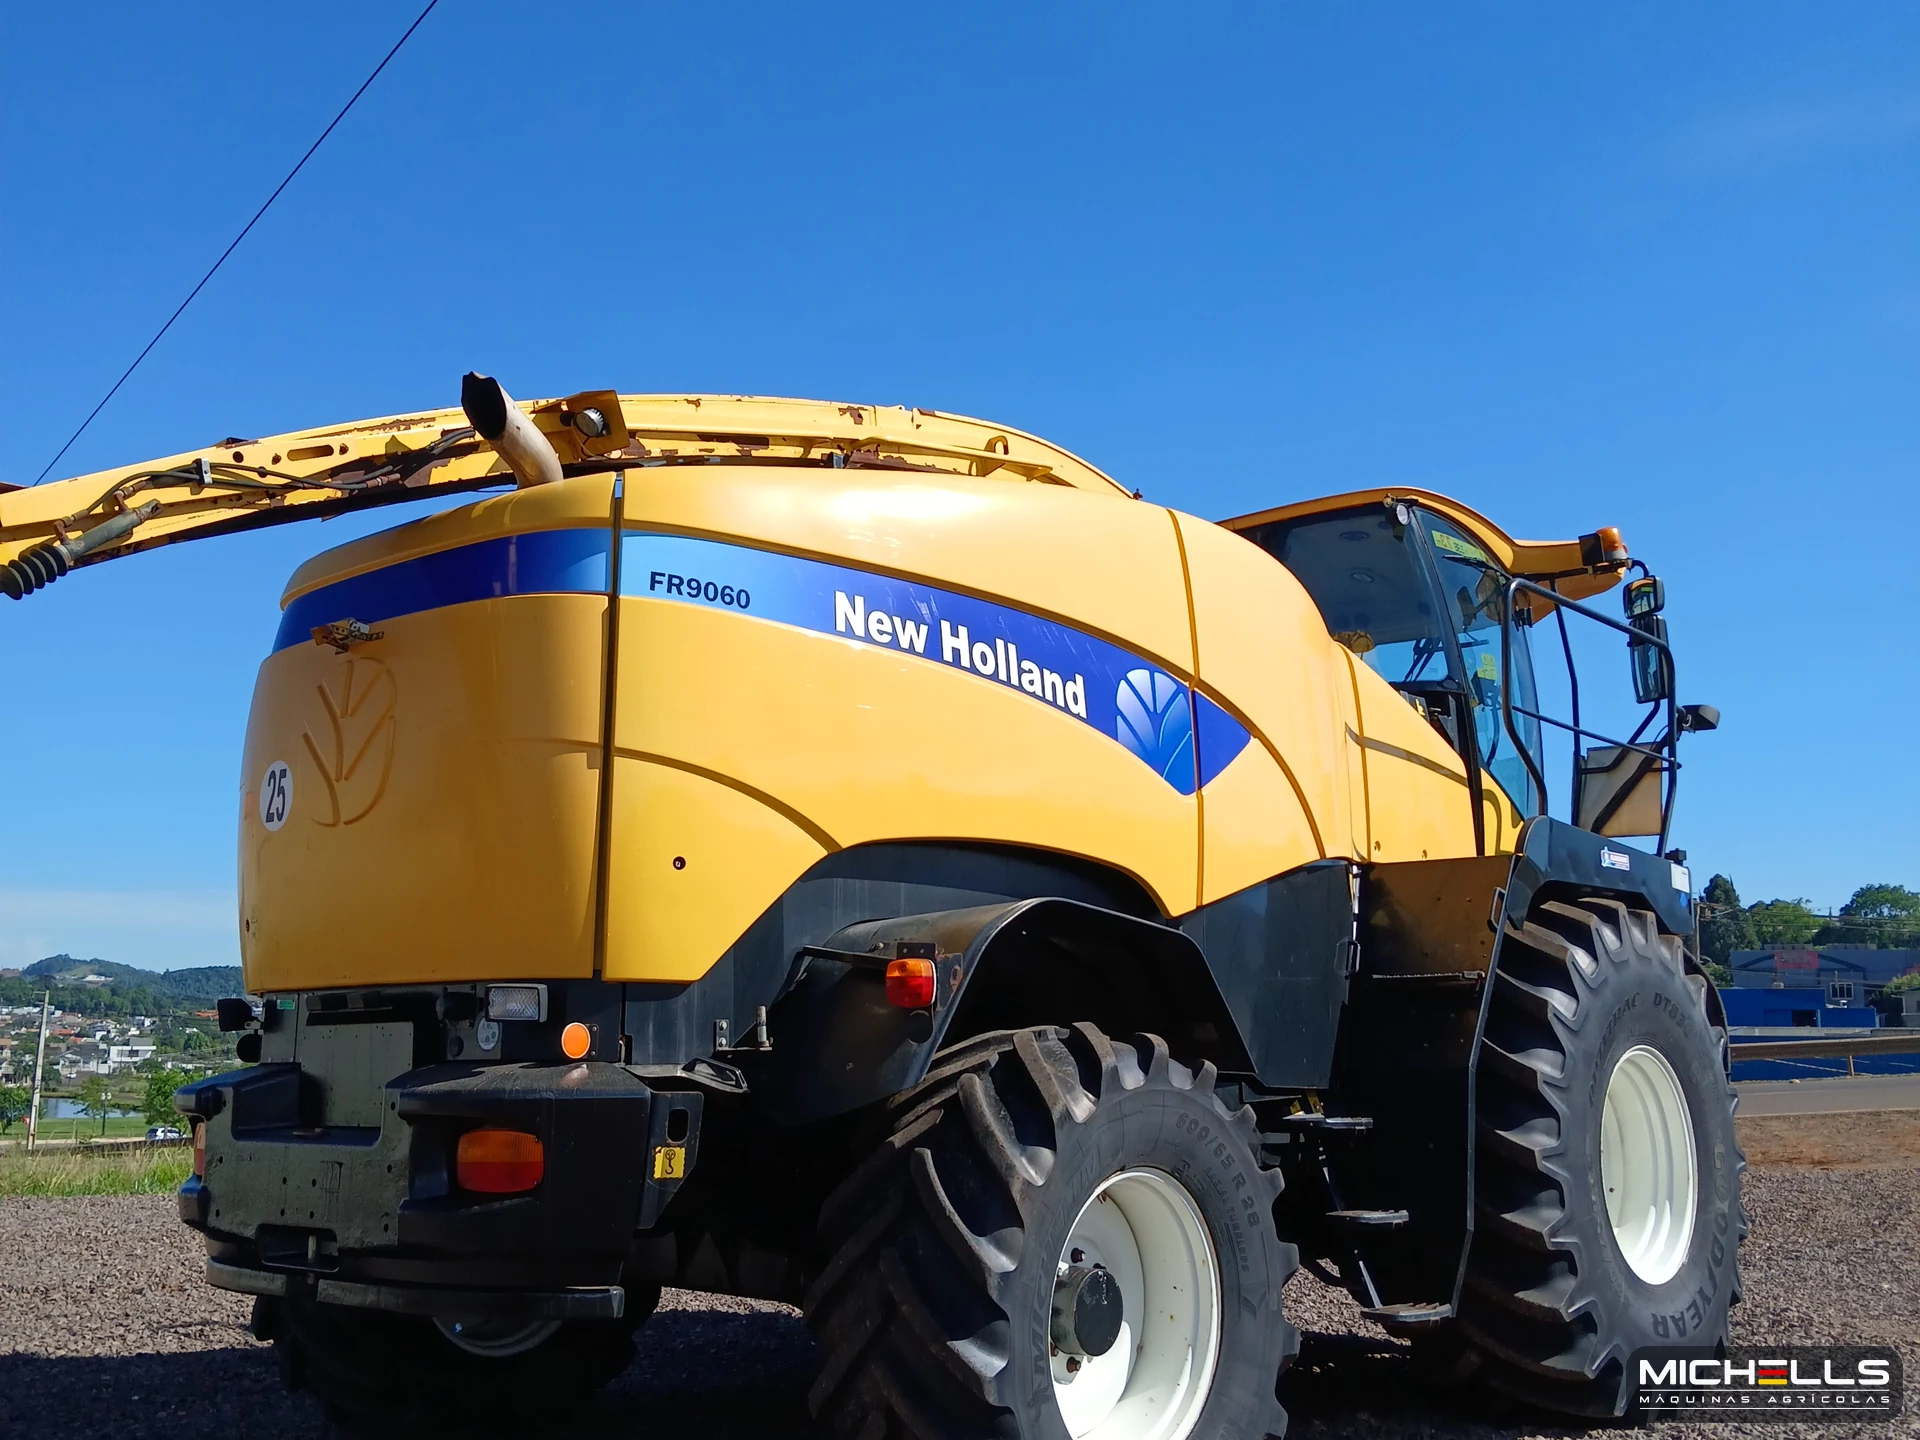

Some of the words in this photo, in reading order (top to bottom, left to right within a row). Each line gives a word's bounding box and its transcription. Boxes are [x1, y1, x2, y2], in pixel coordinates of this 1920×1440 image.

[649, 571, 751, 609] FR9060
[833, 590, 929, 655] New
[940, 618, 1088, 720] Holland
[265, 768, 288, 823] 25
[1651, 1141, 1731, 1339] GOODYEAR
